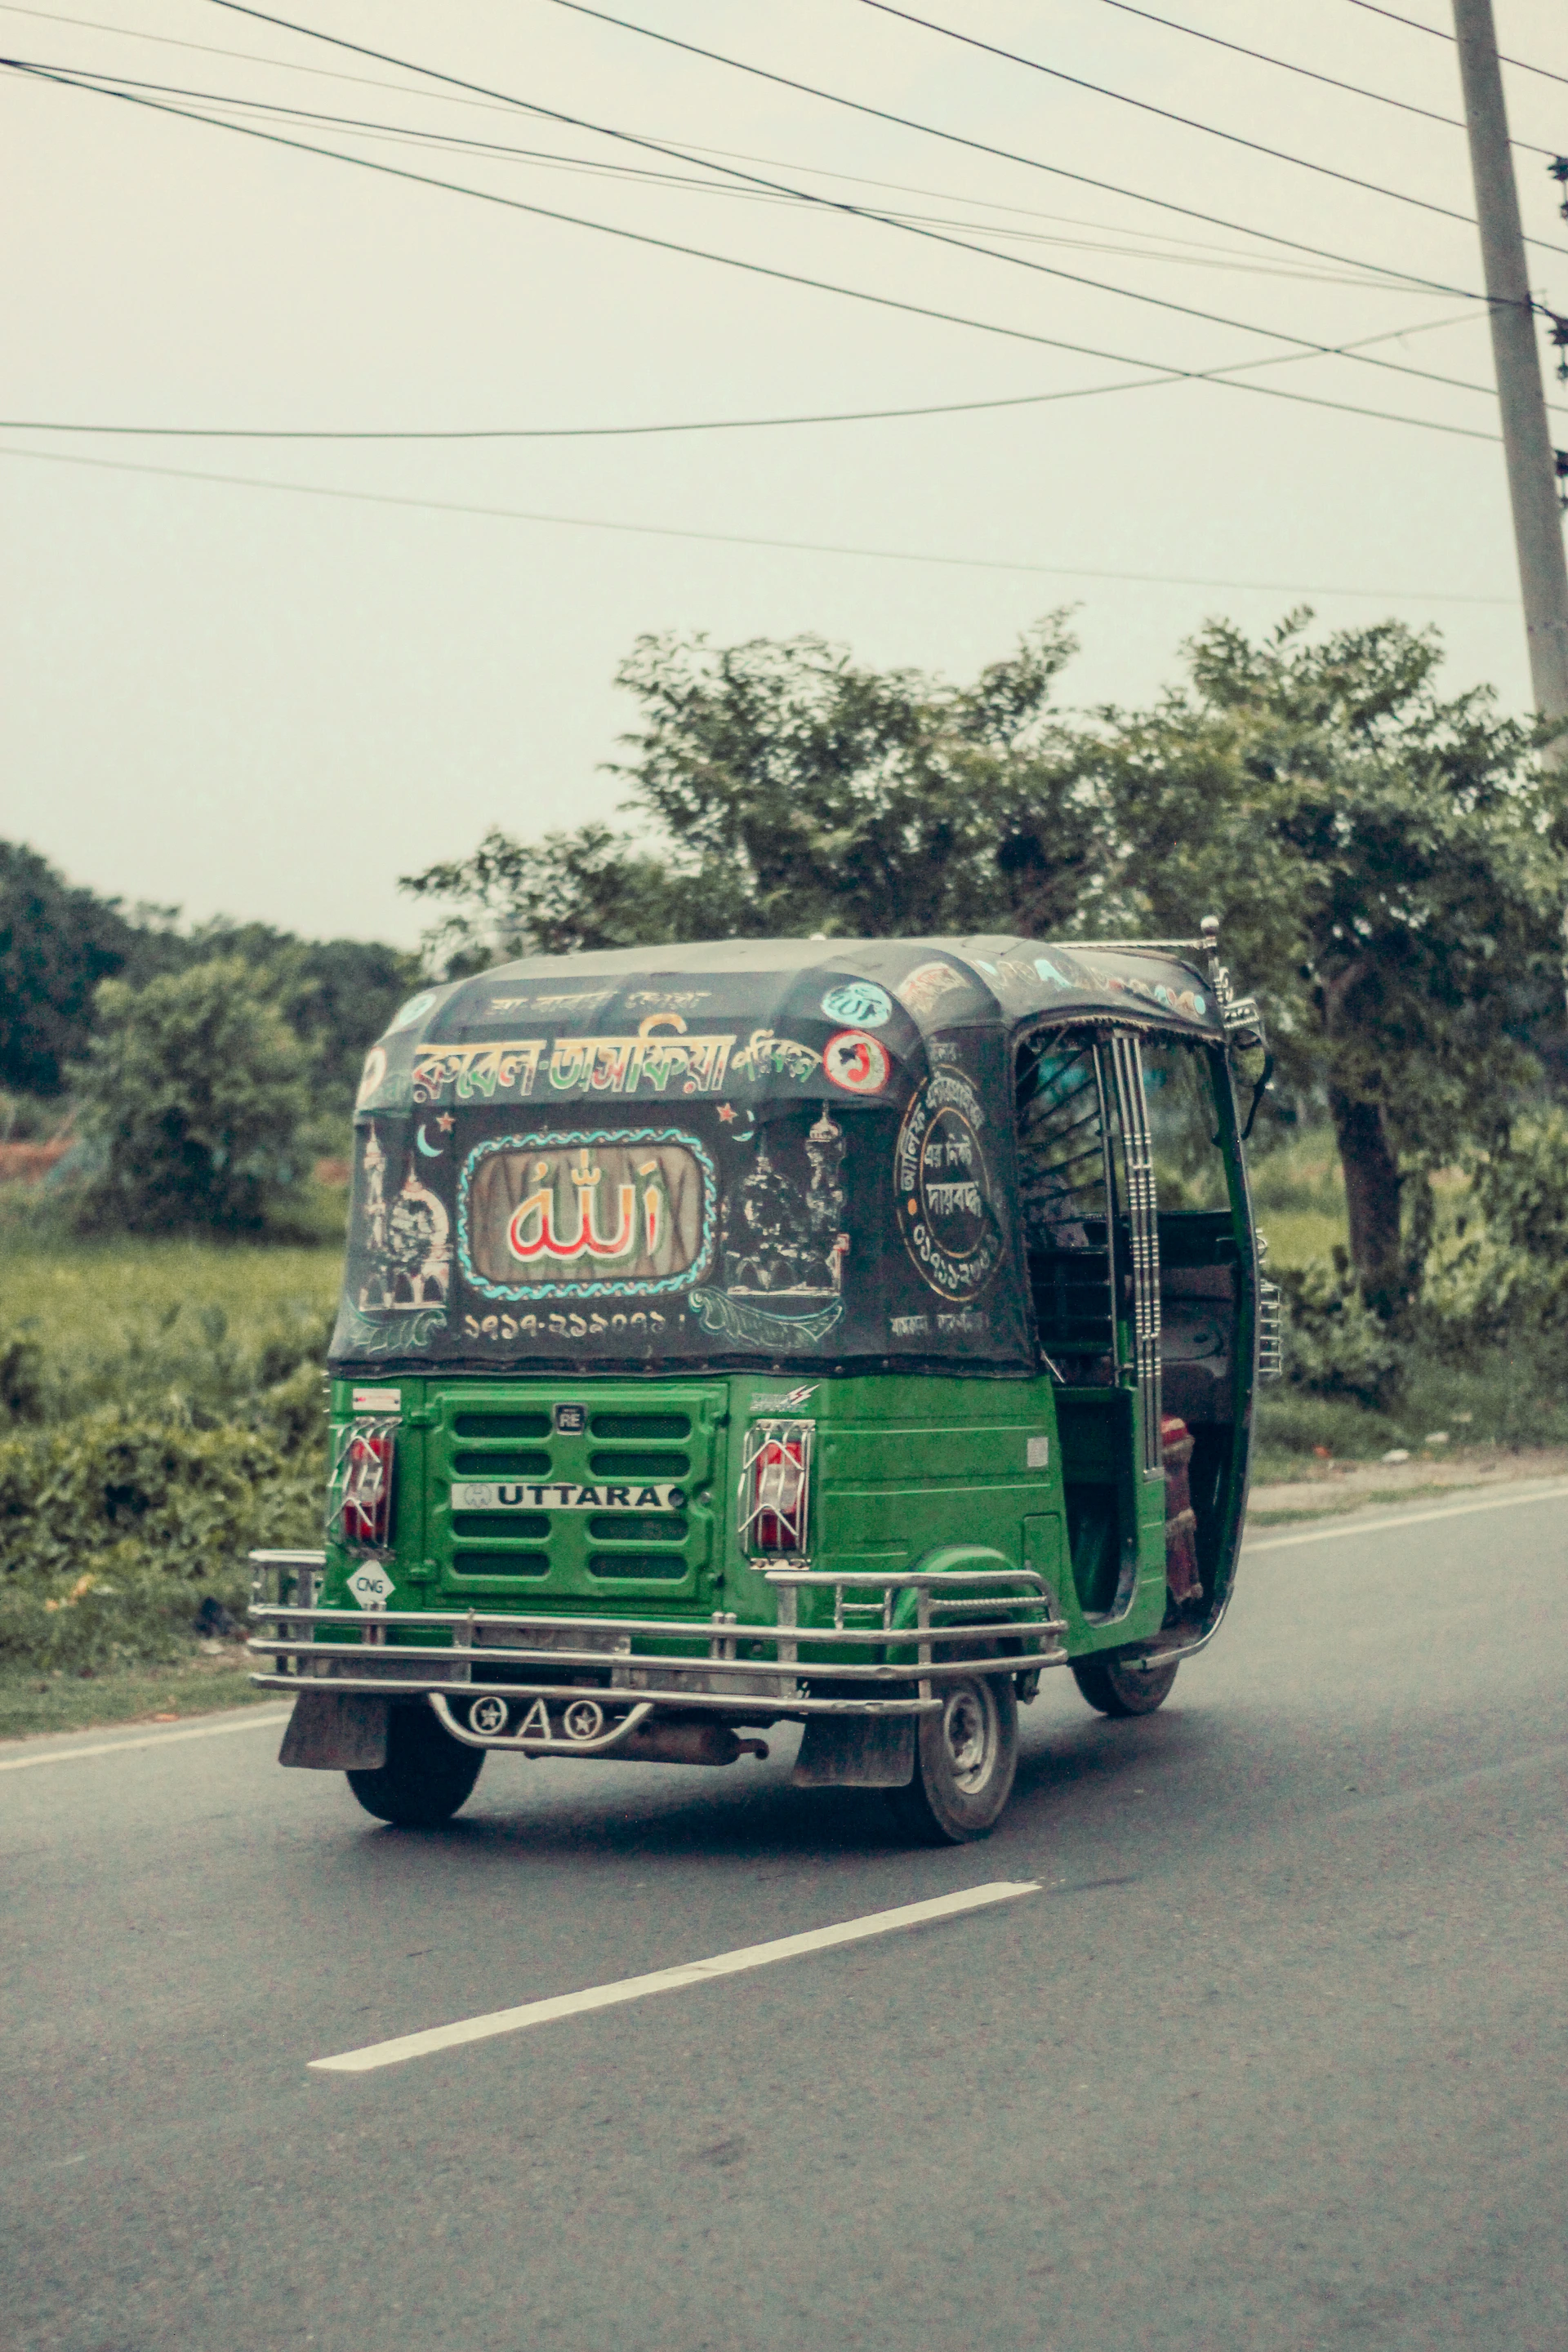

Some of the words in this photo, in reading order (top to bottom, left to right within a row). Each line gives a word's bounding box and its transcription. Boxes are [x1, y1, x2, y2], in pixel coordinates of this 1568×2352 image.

[559, 1414, 581, 1428] RE
[497, 1486, 662, 1507] UTTARA
[357, 1577, 384, 1593] CNG
